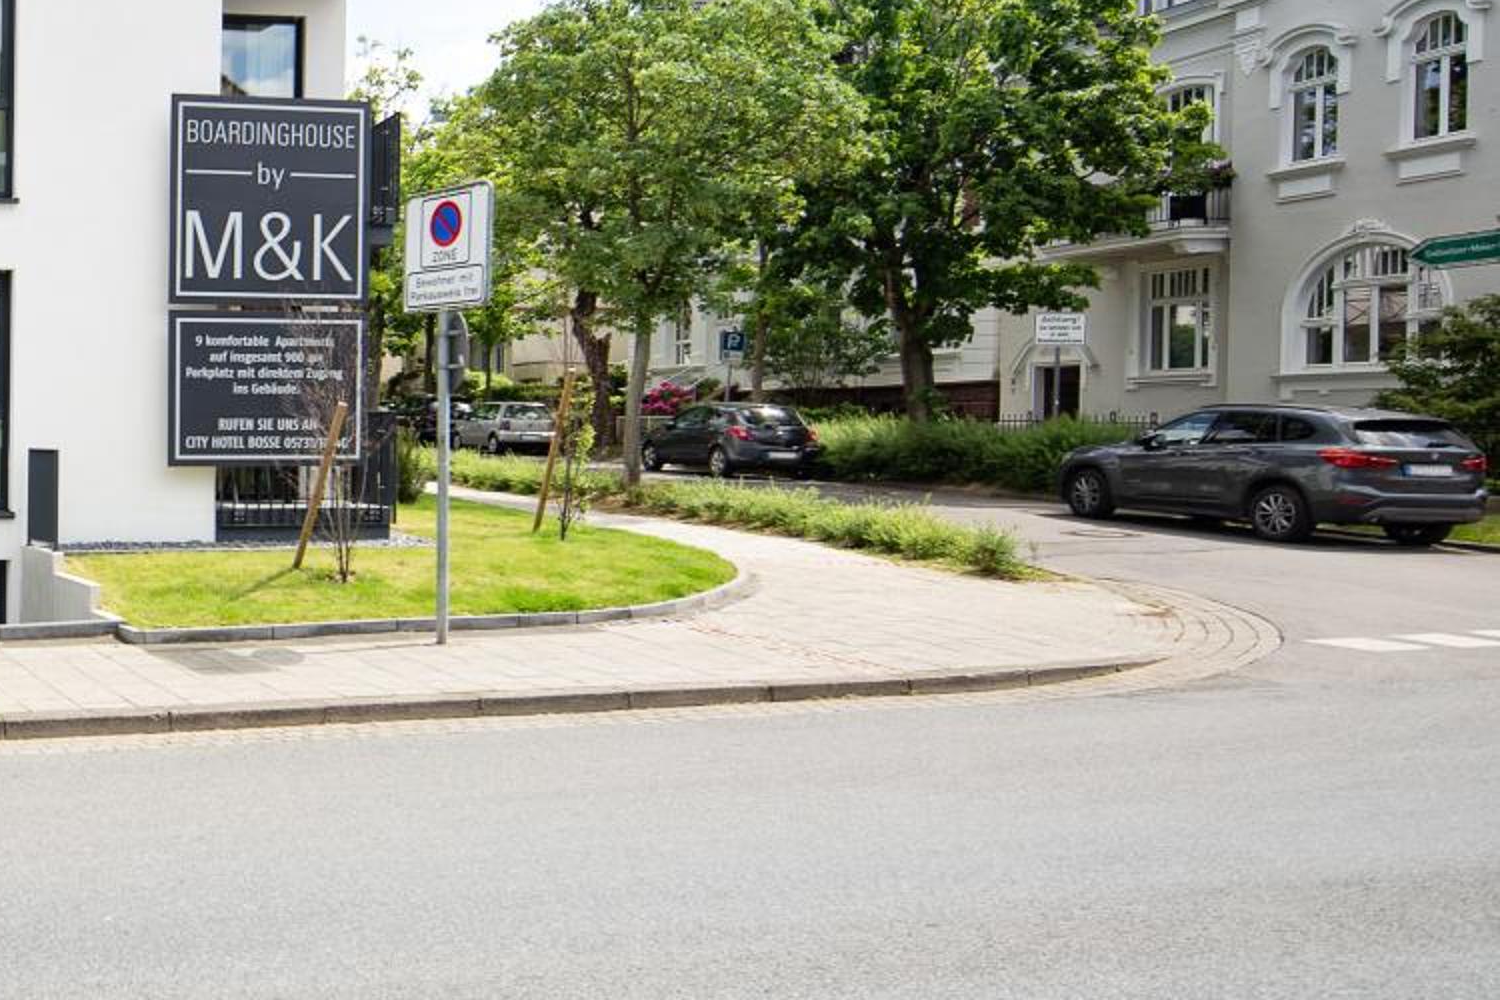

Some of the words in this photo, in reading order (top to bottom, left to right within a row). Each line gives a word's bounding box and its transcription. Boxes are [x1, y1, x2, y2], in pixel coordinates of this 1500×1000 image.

[186, 119, 356, 149] BOARDINGHOUSE
[257, 162, 285, 190] by
[184, 210, 353, 281] M&K
[432, 247, 458, 263] ZONE
[195, 335, 203, 347] 9
[206, 334, 269, 347] komfortable
[209, 351, 227, 363] auf
[230, 351, 282, 365] insgesamt
[185, 366, 234, 380] Parkplatz
[237, 366, 255, 379] mit
[258, 366, 303, 379] direktem
[233, 382, 248, 394] ins
[217, 417, 254, 431] RUFEN
[257, 417, 274, 431] SIE
[277, 417, 299, 431] UNS
[185, 436, 209, 449] CITY
[211, 436, 244, 449] HOTEL
[248, 436, 281, 449] BOSSE
